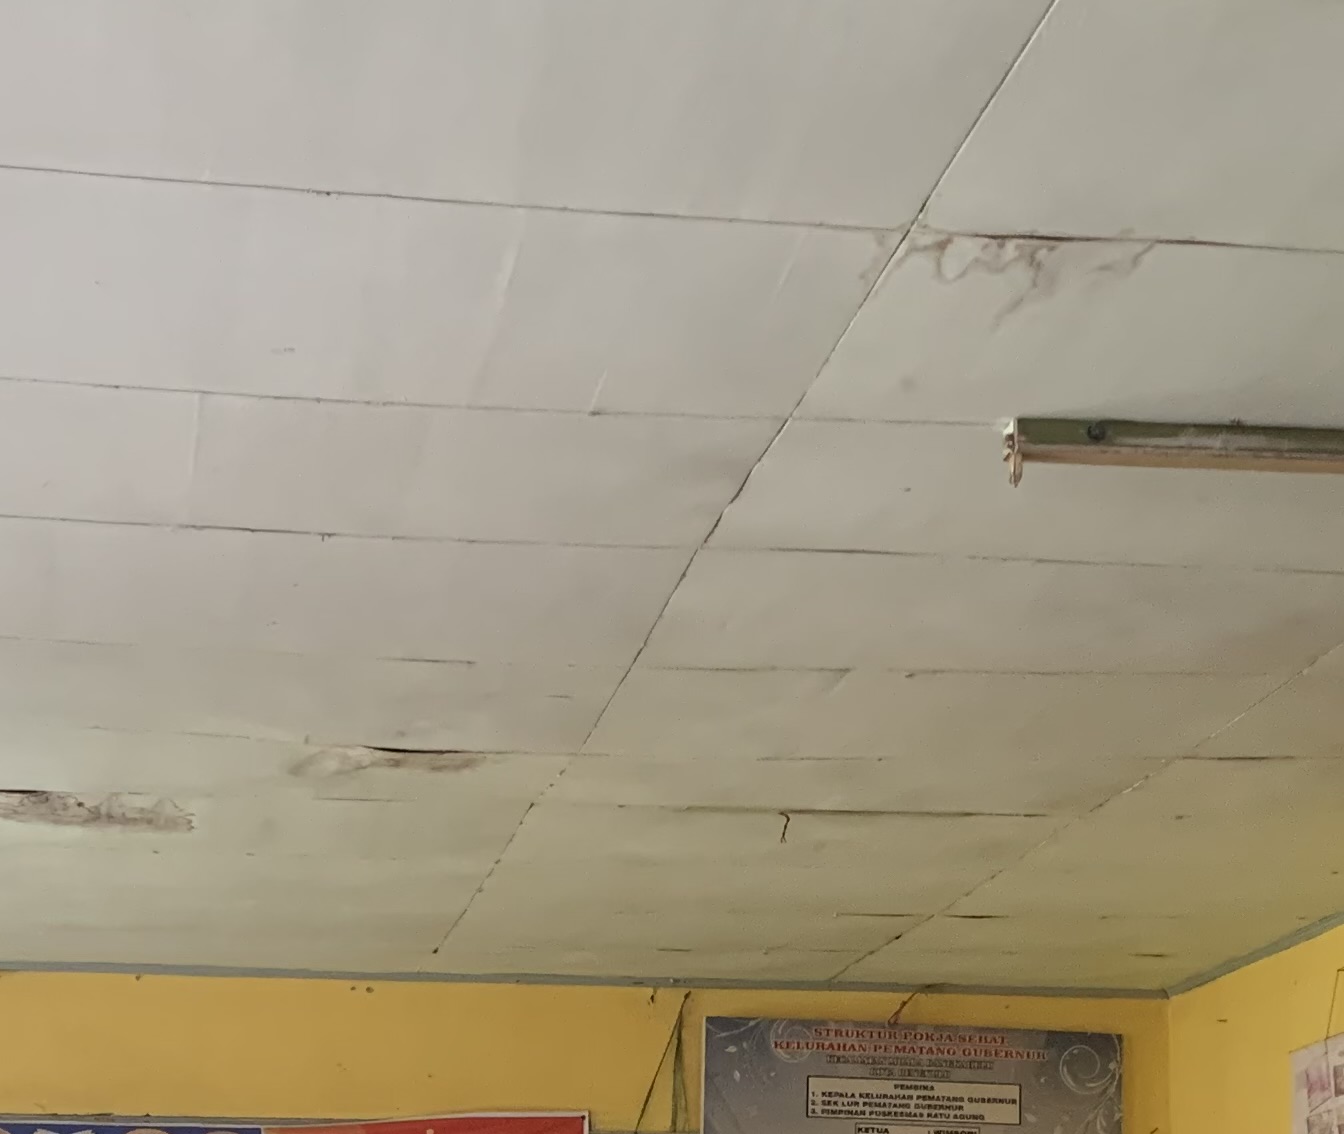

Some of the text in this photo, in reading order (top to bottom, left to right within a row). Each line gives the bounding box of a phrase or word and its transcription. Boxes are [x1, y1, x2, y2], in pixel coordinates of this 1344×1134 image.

[813, 1027, 900, 1041] STRUKTUR
[773, 1040, 867, 1053] KELURAHAN
[962, 1048, 1048, 1061] GUBERNUR
[859, 1093, 913, 1101] KELURAHAN
[857, 1127, 889, 1134] KETUA
